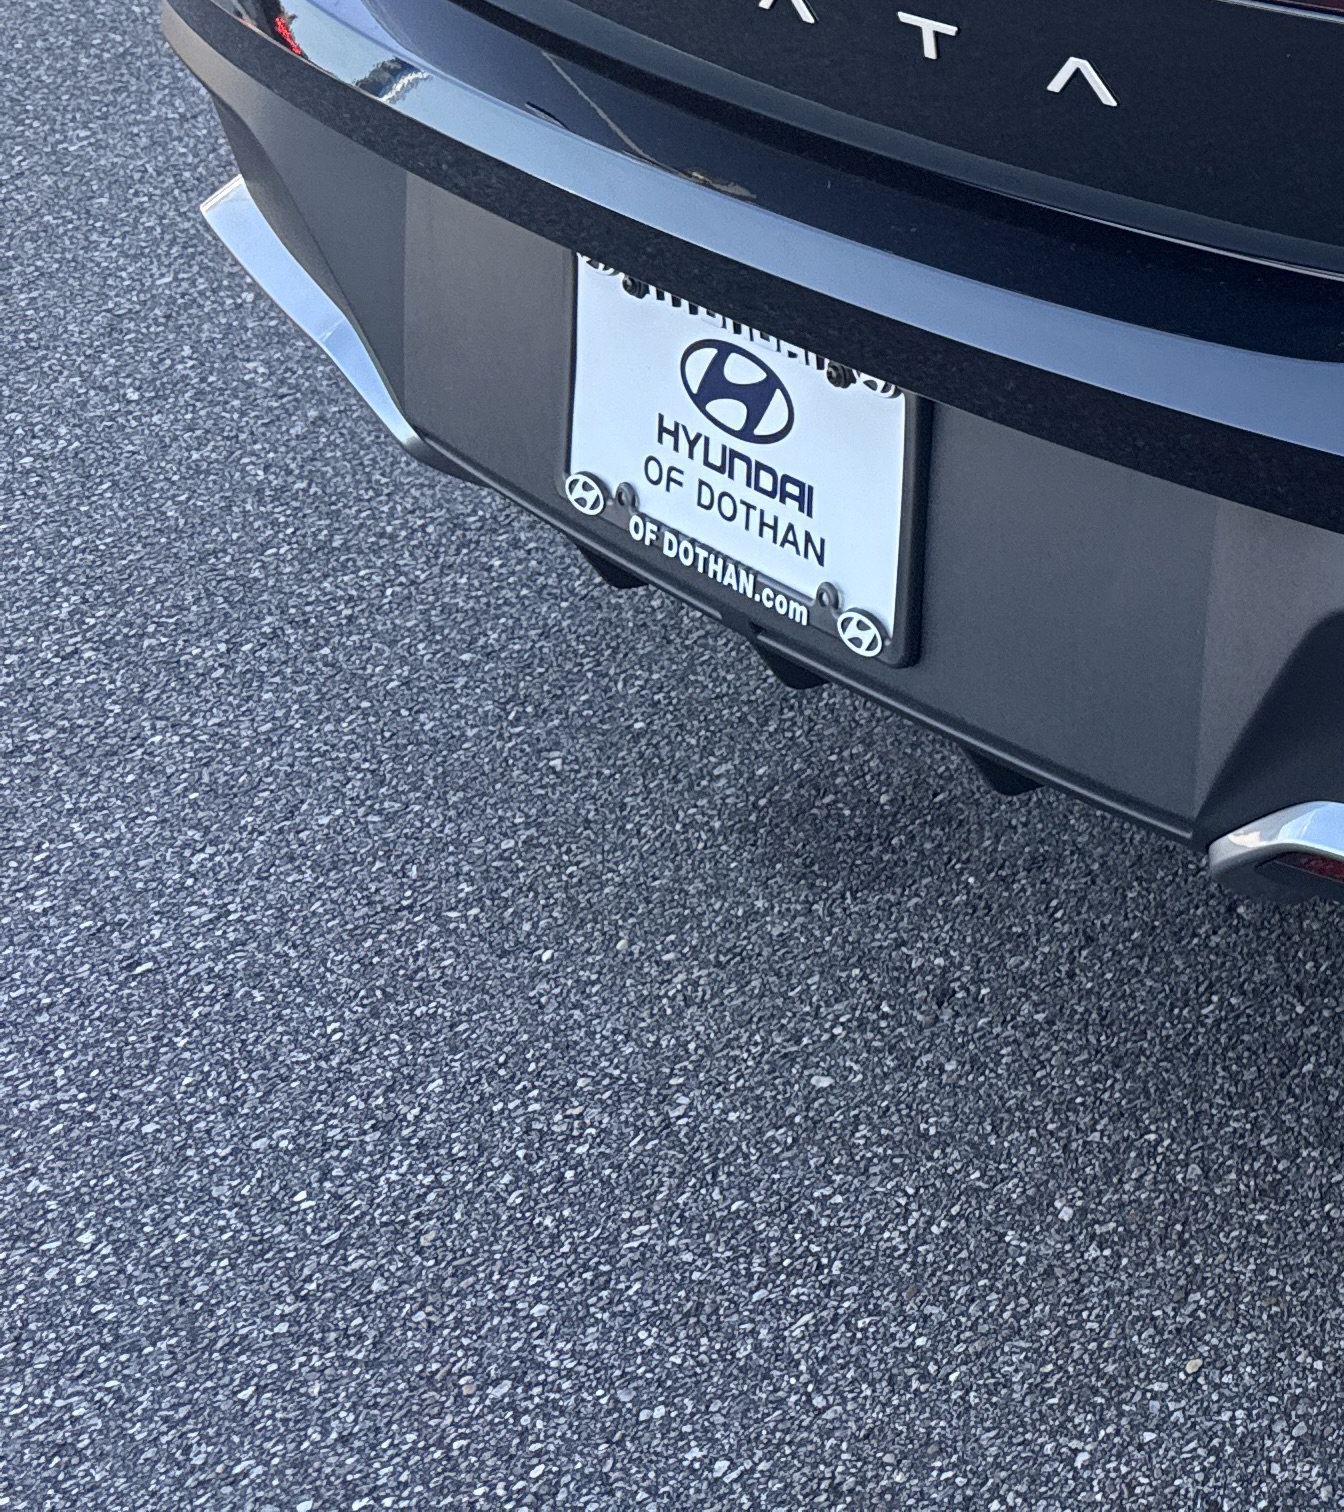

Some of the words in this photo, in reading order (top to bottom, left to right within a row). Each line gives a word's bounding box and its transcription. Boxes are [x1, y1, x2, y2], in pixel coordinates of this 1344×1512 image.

[643, 454, 685, 494] OF
[696, 478, 826, 568] DOTHAN
[657, 412, 814, 519] HYUNDAI
[629, 514, 659, 547] OF
[662, 530, 809, 626] DOTHAN.com
